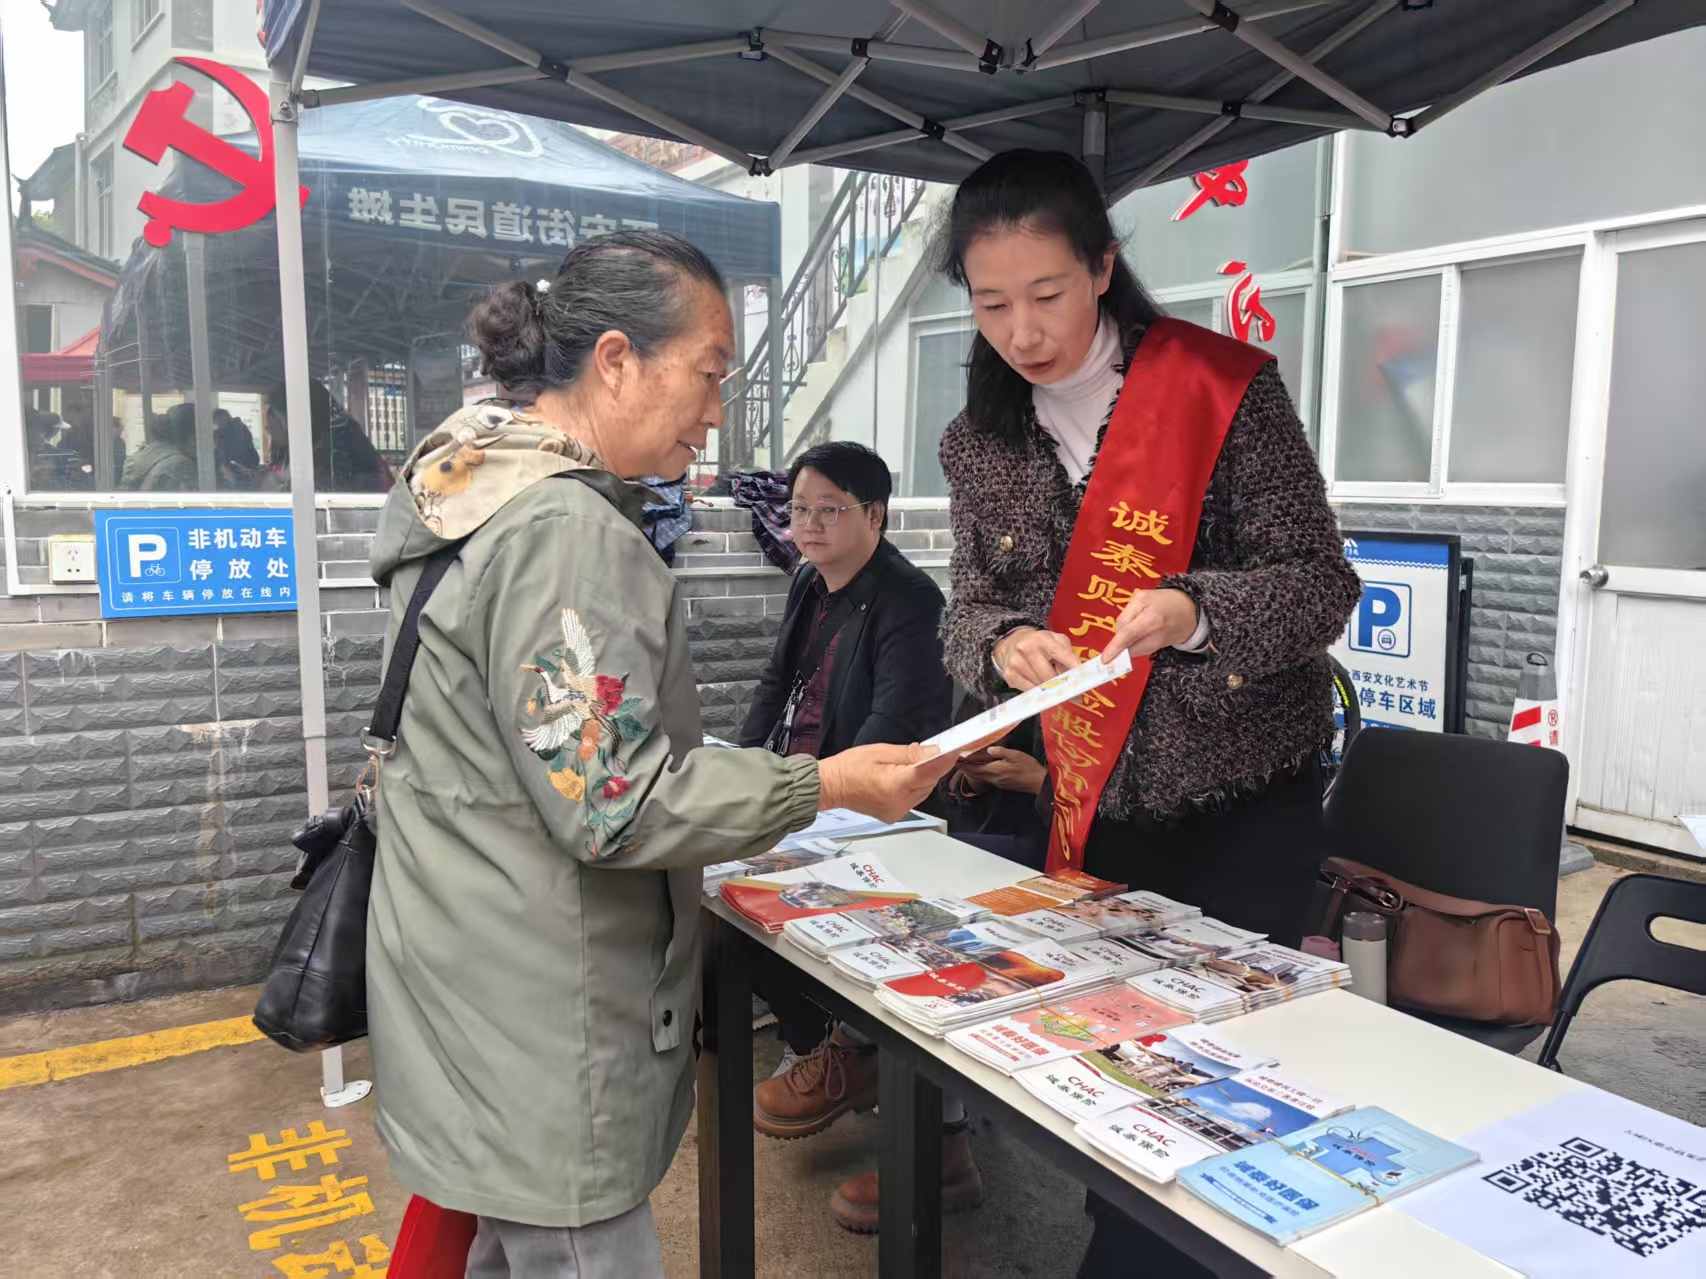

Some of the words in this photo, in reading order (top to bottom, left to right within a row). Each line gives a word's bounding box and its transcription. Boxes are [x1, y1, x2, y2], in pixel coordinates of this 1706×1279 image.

[188, 527, 287, 549] 非机动车
[128, 534, 167, 578] P
[190, 558, 289, 581] 停放处
[121, 586, 291, 603] 请将车辆停放在线内
[1357, 586, 1402, 648] P
[1170, 976, 1206, 993] CHAC
[1067, 1075, 1106, 1098] CHAC
[1132, 1122, 1177, 1148] CHAC
